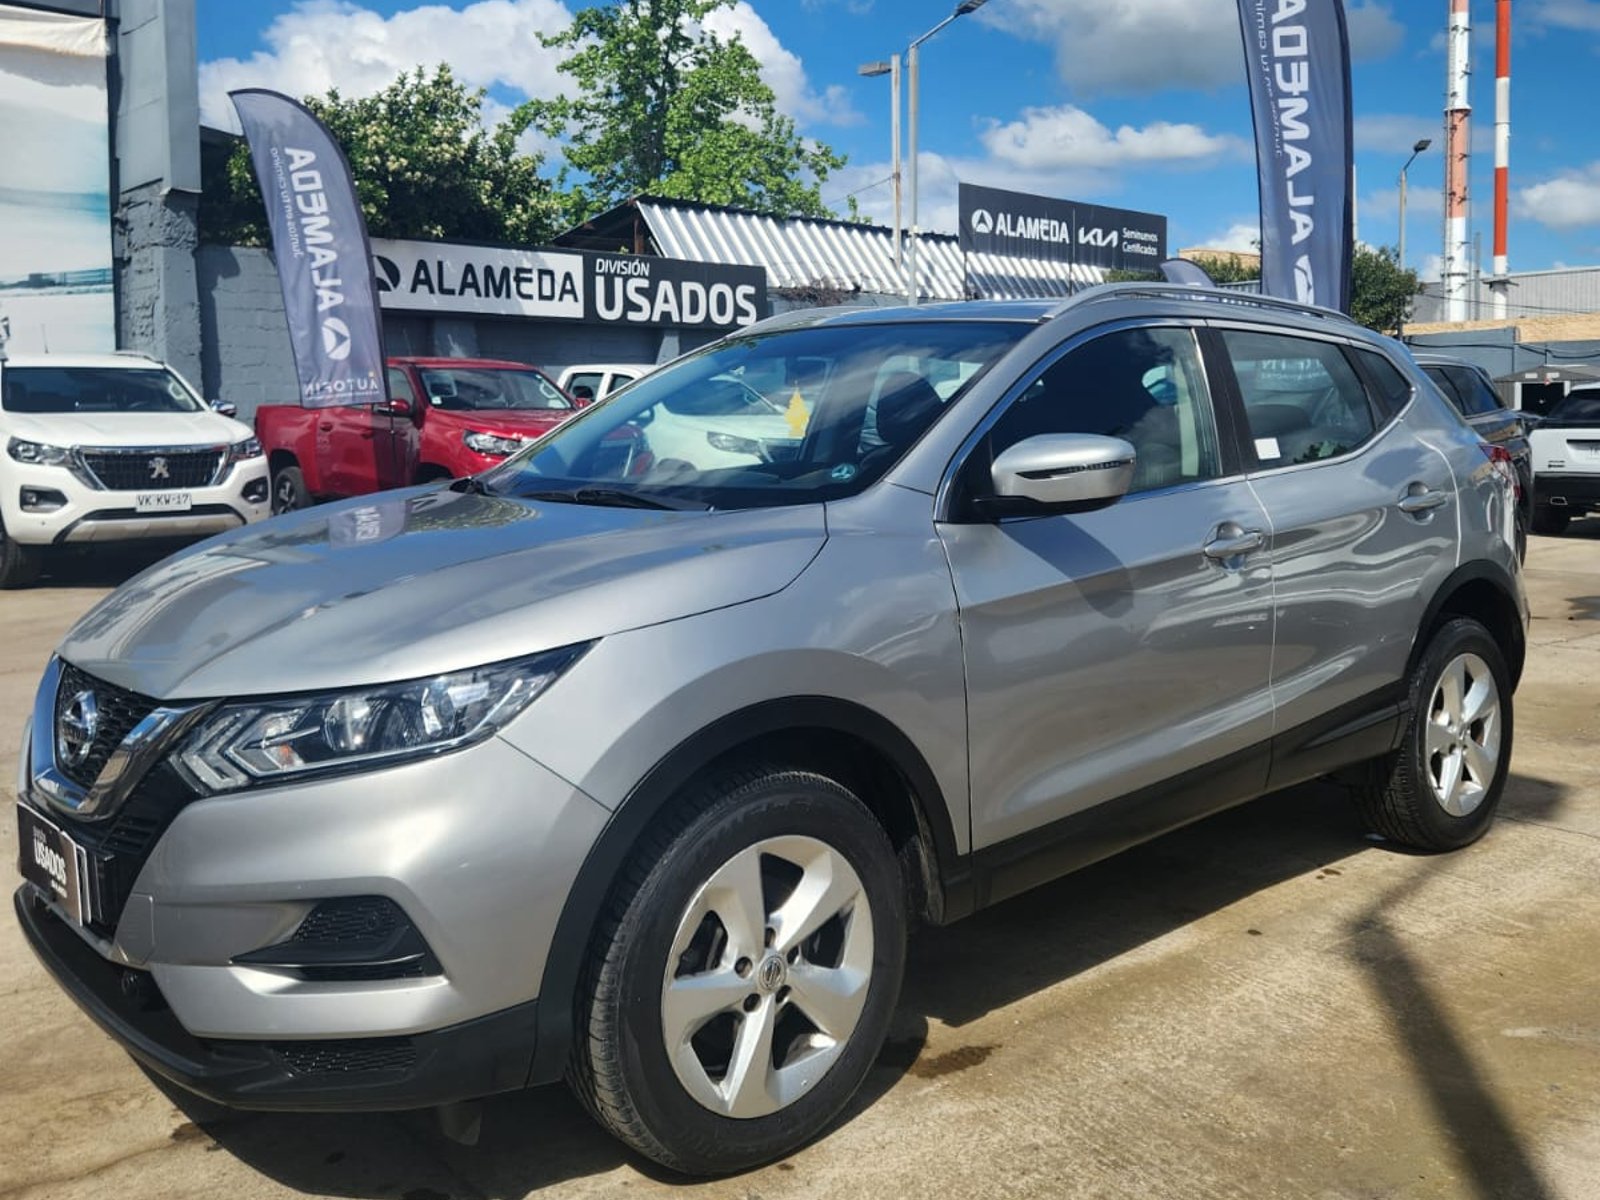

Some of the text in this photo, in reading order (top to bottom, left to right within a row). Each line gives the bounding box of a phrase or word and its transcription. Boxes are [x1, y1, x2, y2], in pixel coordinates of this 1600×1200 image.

[995, 212, 1070, 244] ALAMEDA
[1122, 227, 1158, 242] Seminuevos
[1122, 241, 1158, 256] Certificados
[410, 258, 579, 302] ALAMEDA
[595, 258, 650, 277] DIVISIÓN
[595, 275, 757, 326] USADOS
[33, 838, 67, 886] USADOS
